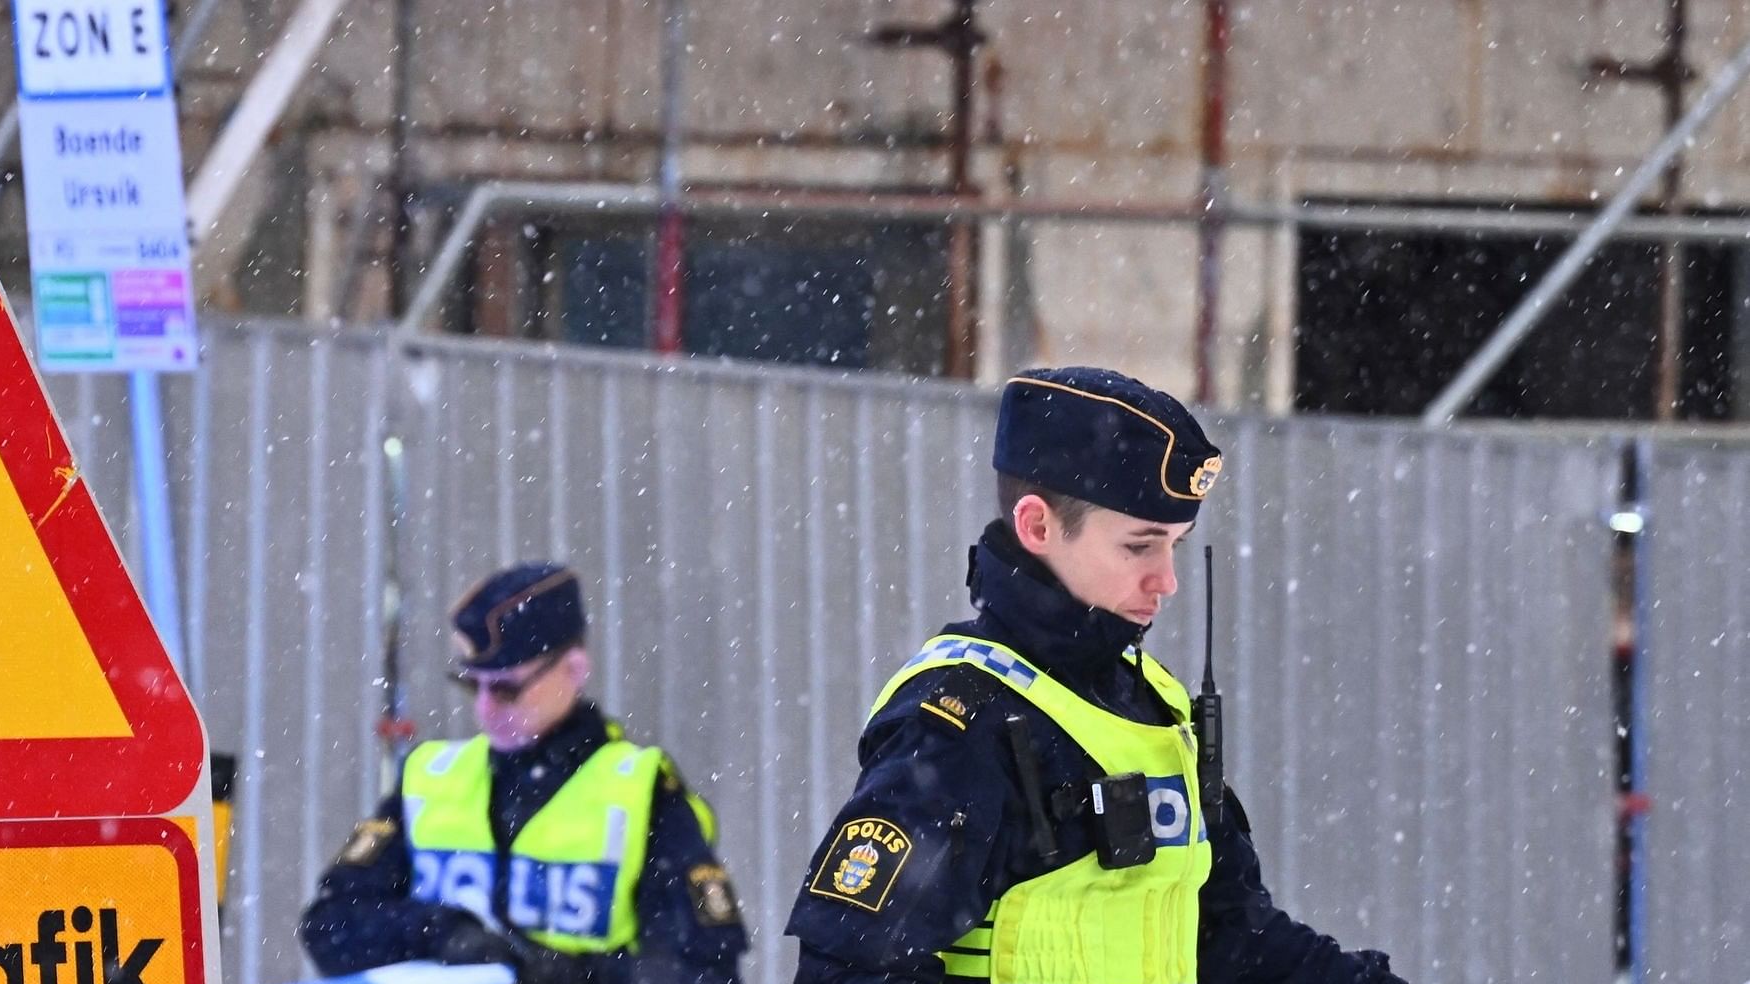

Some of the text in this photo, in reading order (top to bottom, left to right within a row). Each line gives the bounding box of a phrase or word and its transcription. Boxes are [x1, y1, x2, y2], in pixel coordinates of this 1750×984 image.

[33, 6, 148, 58] ZON E
[847, 821, 905, 853] POLIS
